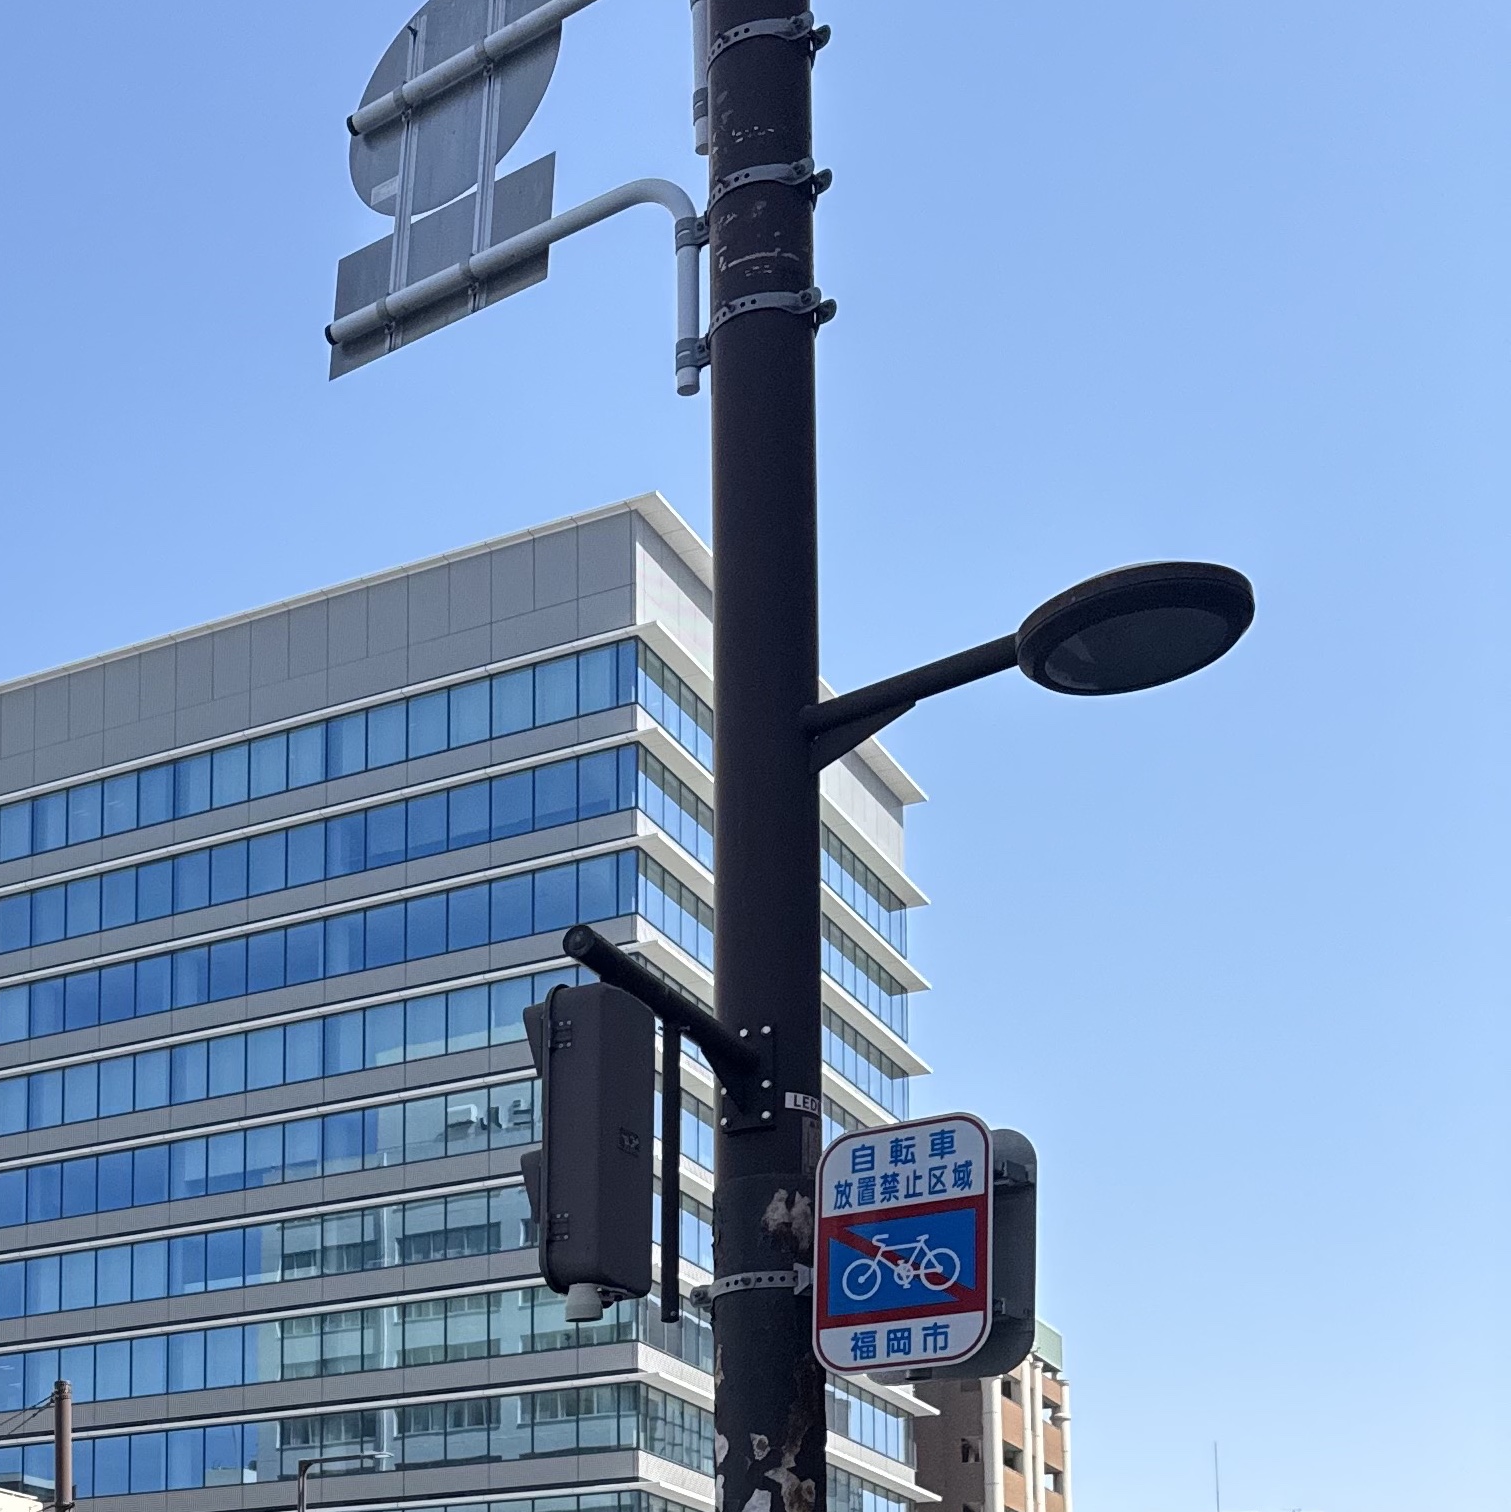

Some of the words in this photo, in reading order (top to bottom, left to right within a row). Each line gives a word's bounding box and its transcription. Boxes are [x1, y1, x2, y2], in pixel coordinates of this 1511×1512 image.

[794, 1094, 821, 1112] LED
[851, 1129, 957, 1173] 自転車
[833, 1159, 973, 1211] 放置禁止区域
[850, 1321, 950, 1362] 福岡市
